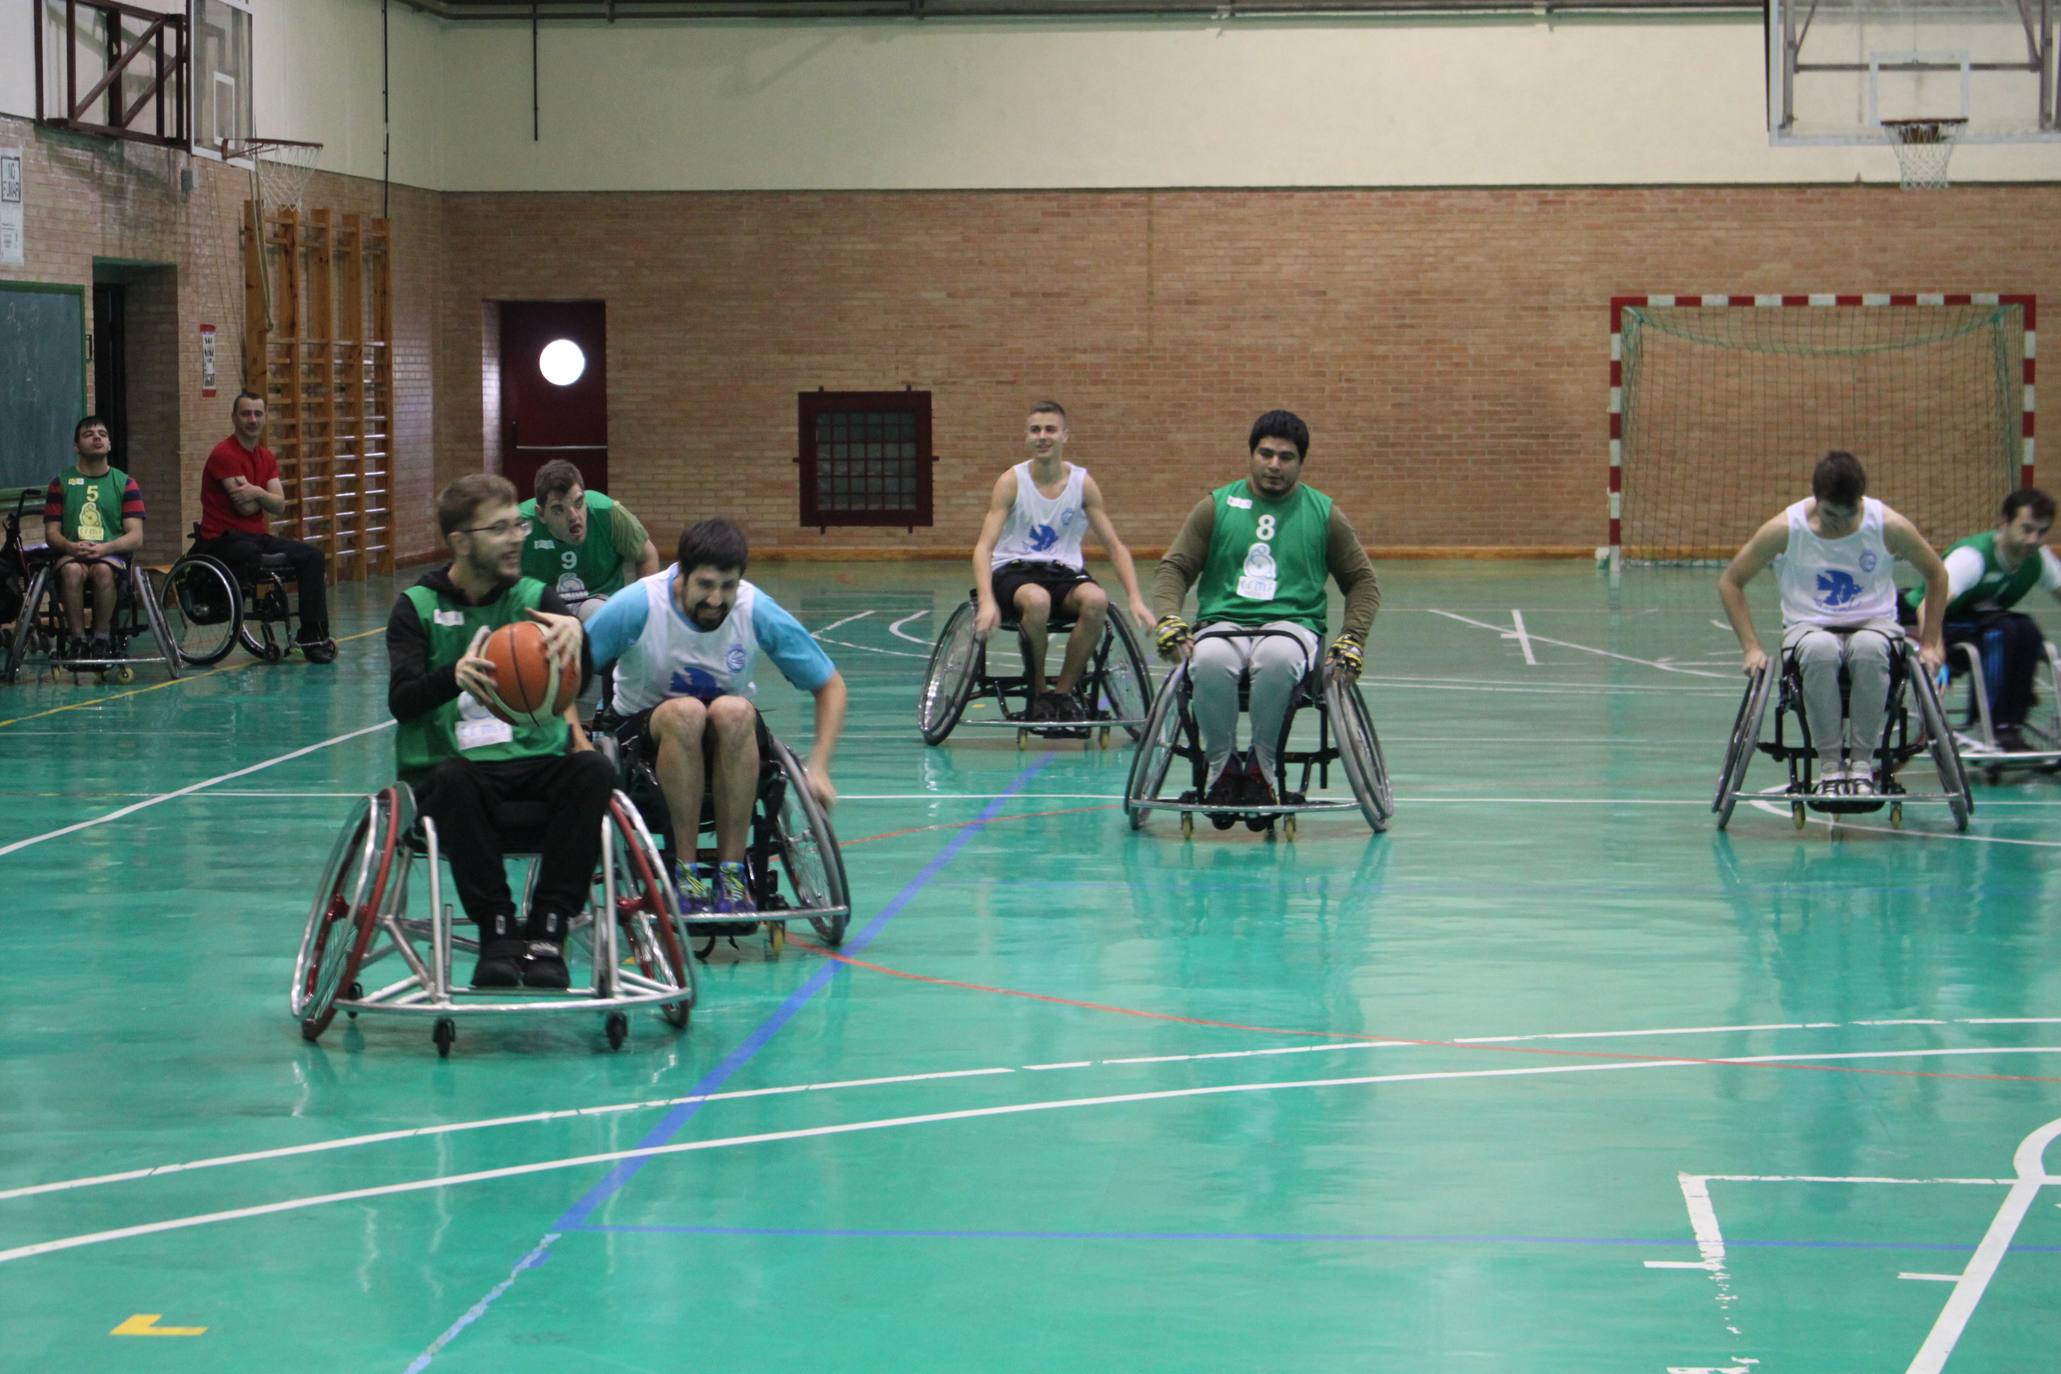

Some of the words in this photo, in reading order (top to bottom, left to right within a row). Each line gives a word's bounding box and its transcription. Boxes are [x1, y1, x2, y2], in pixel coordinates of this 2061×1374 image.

[86, 485, 99, 502] 5
[1256, 514, 1276, 541] 8
[561, 551, 578, 570] 9
